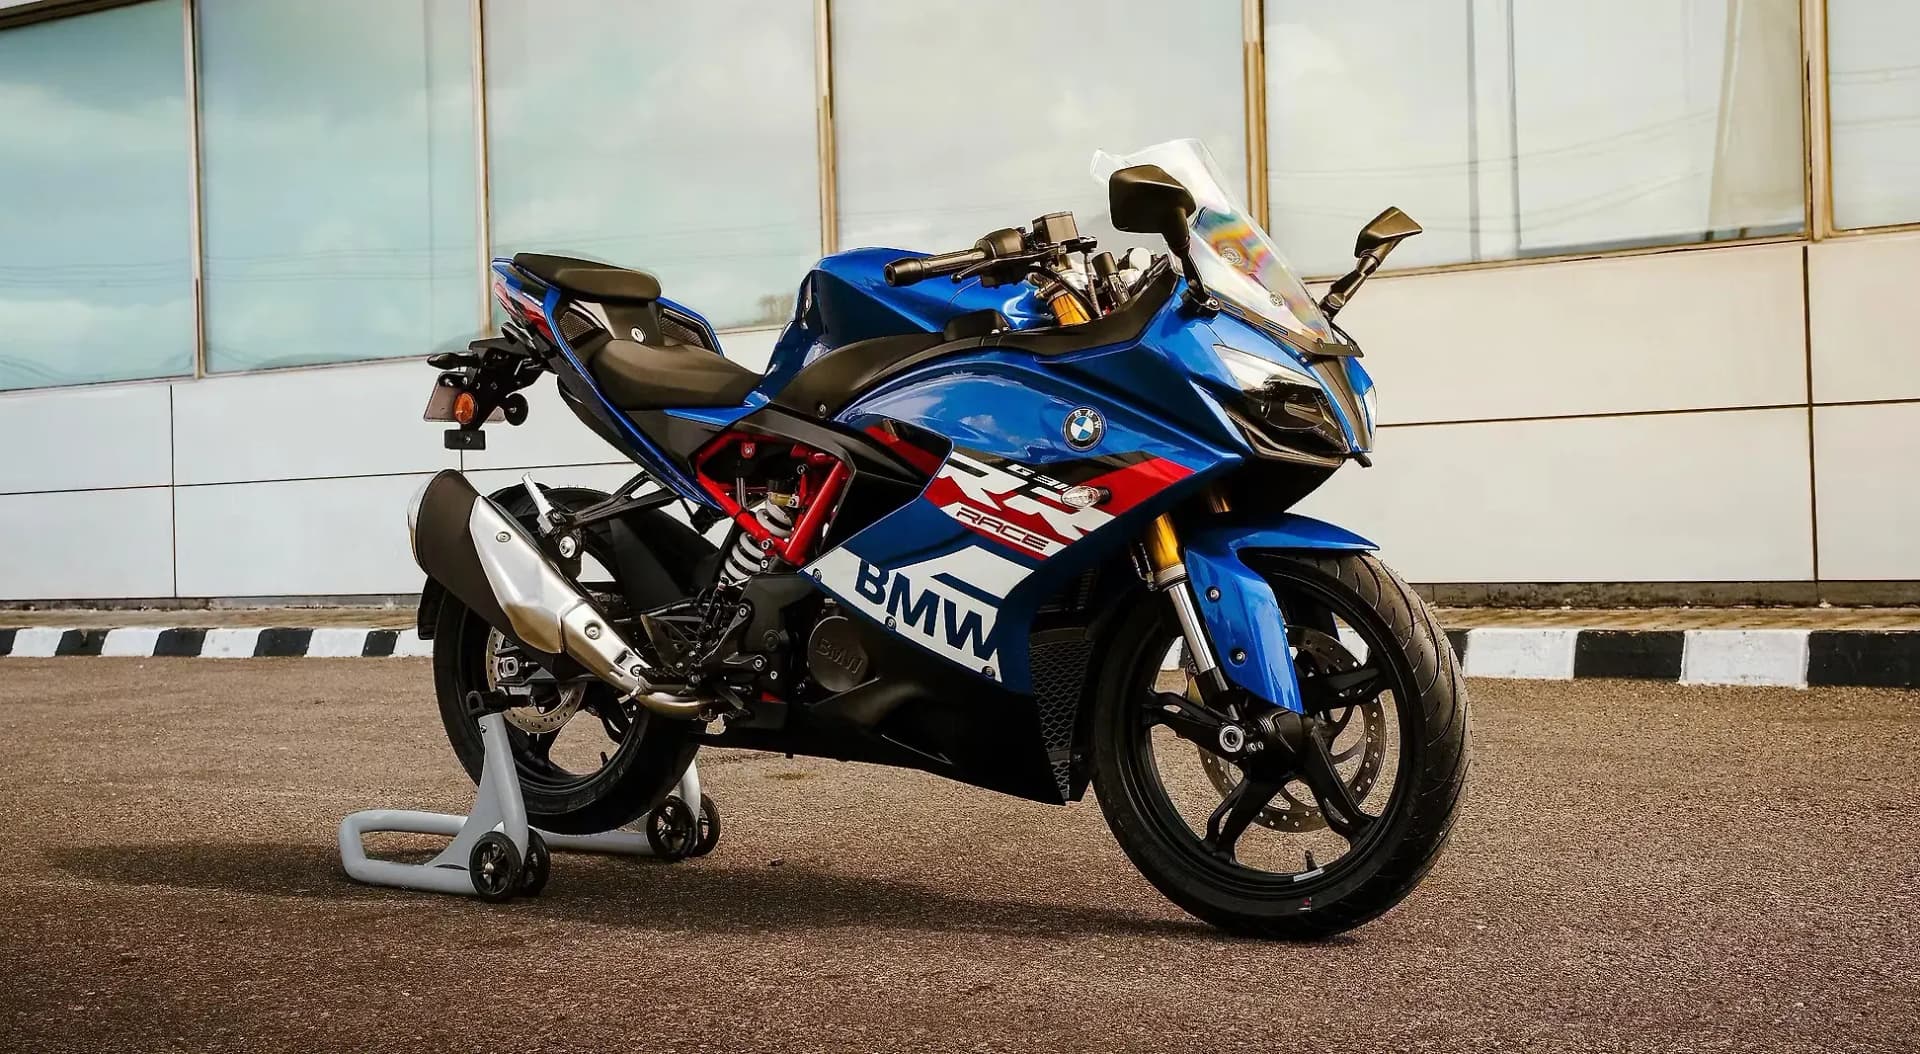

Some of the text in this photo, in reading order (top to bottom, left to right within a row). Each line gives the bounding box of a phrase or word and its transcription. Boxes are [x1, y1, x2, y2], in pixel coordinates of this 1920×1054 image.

[1006, 463, 1036, 477] G
[956, 506, 1050, 552] RACE
[855, 559, 999, 661] BMW
[815, 636, 865, 674] BMW
